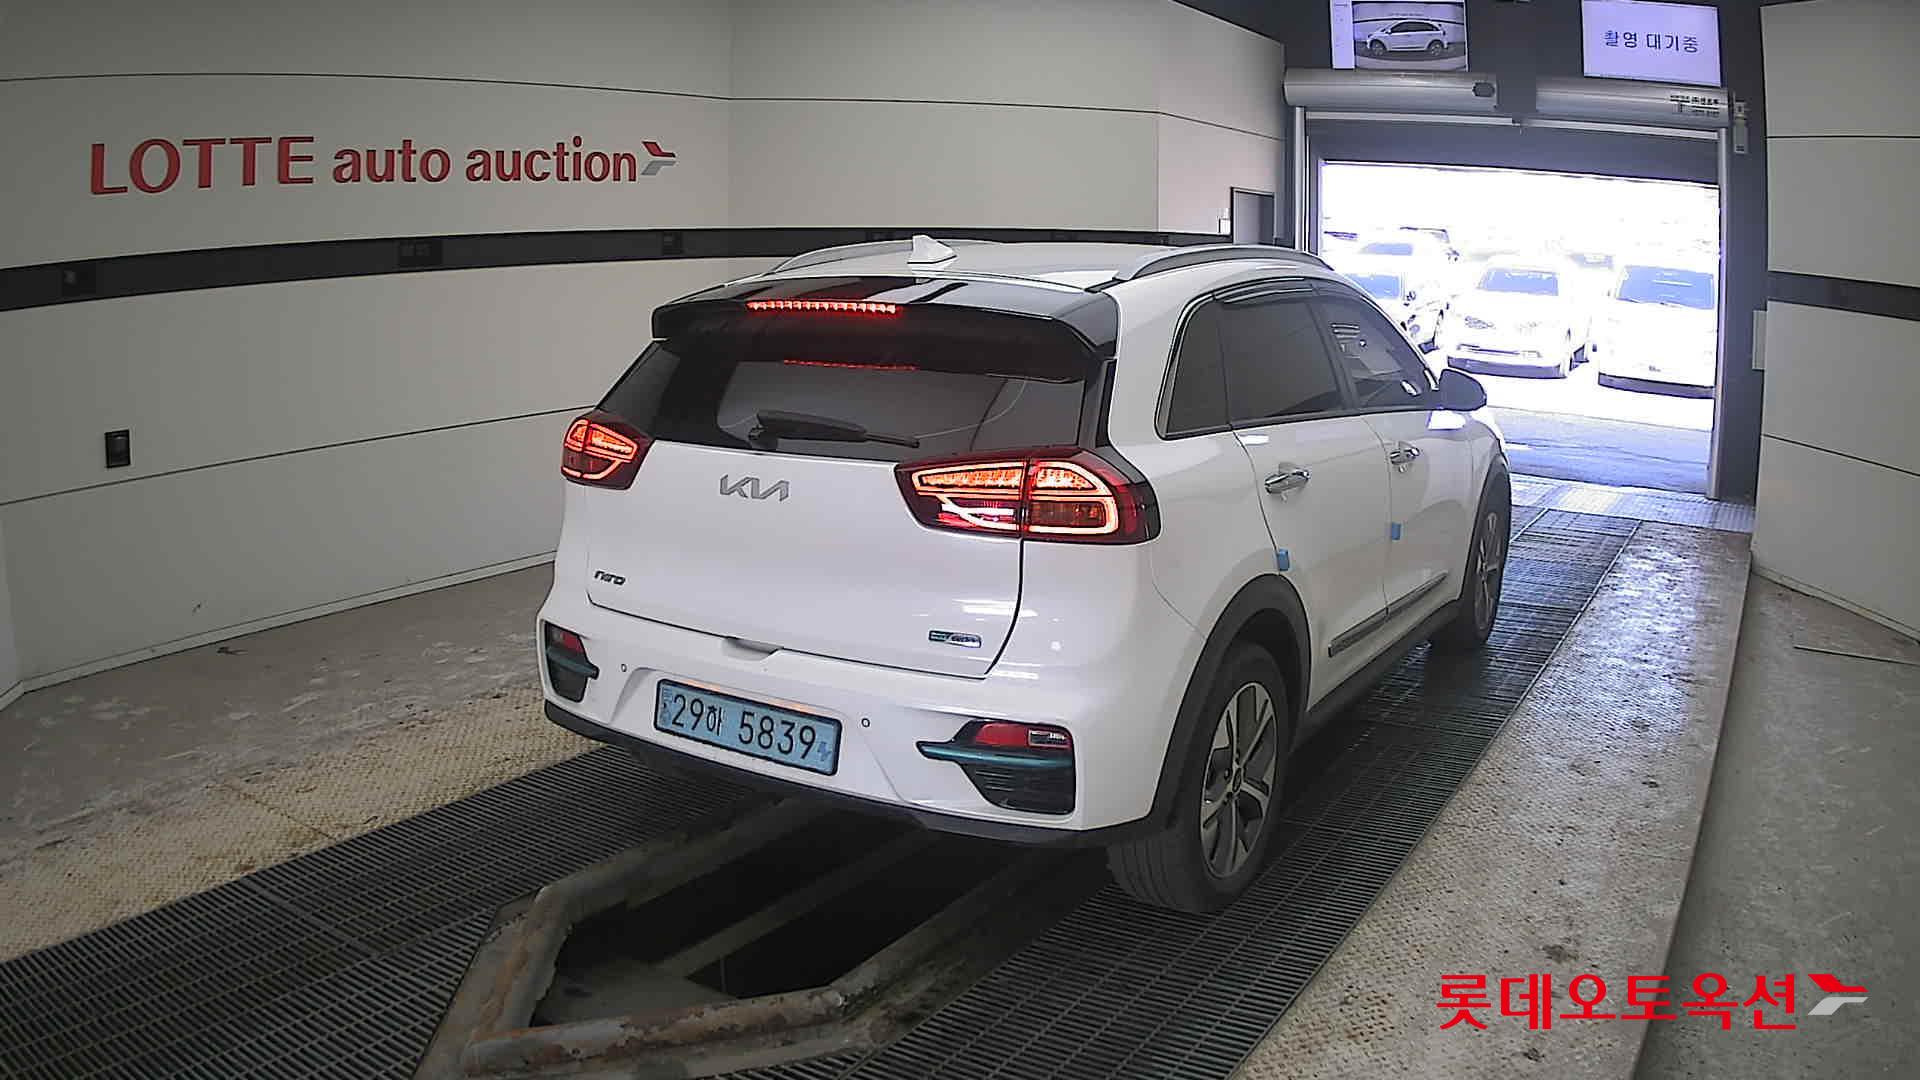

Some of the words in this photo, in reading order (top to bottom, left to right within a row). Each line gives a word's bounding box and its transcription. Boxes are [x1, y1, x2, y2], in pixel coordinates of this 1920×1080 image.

[1603, 30, 1638, 49] 촬영
[1646, 33, 1698, 53] 대기중
[90, 136, 315, 195] LOTTE
[333, 138, 451, 184] auto
[465, 135, 637, 183] auction
[719, 473, 790, 503] KIA
[671, 693, 723, 737] 29하
[738, 710, 817, 760] 5839
